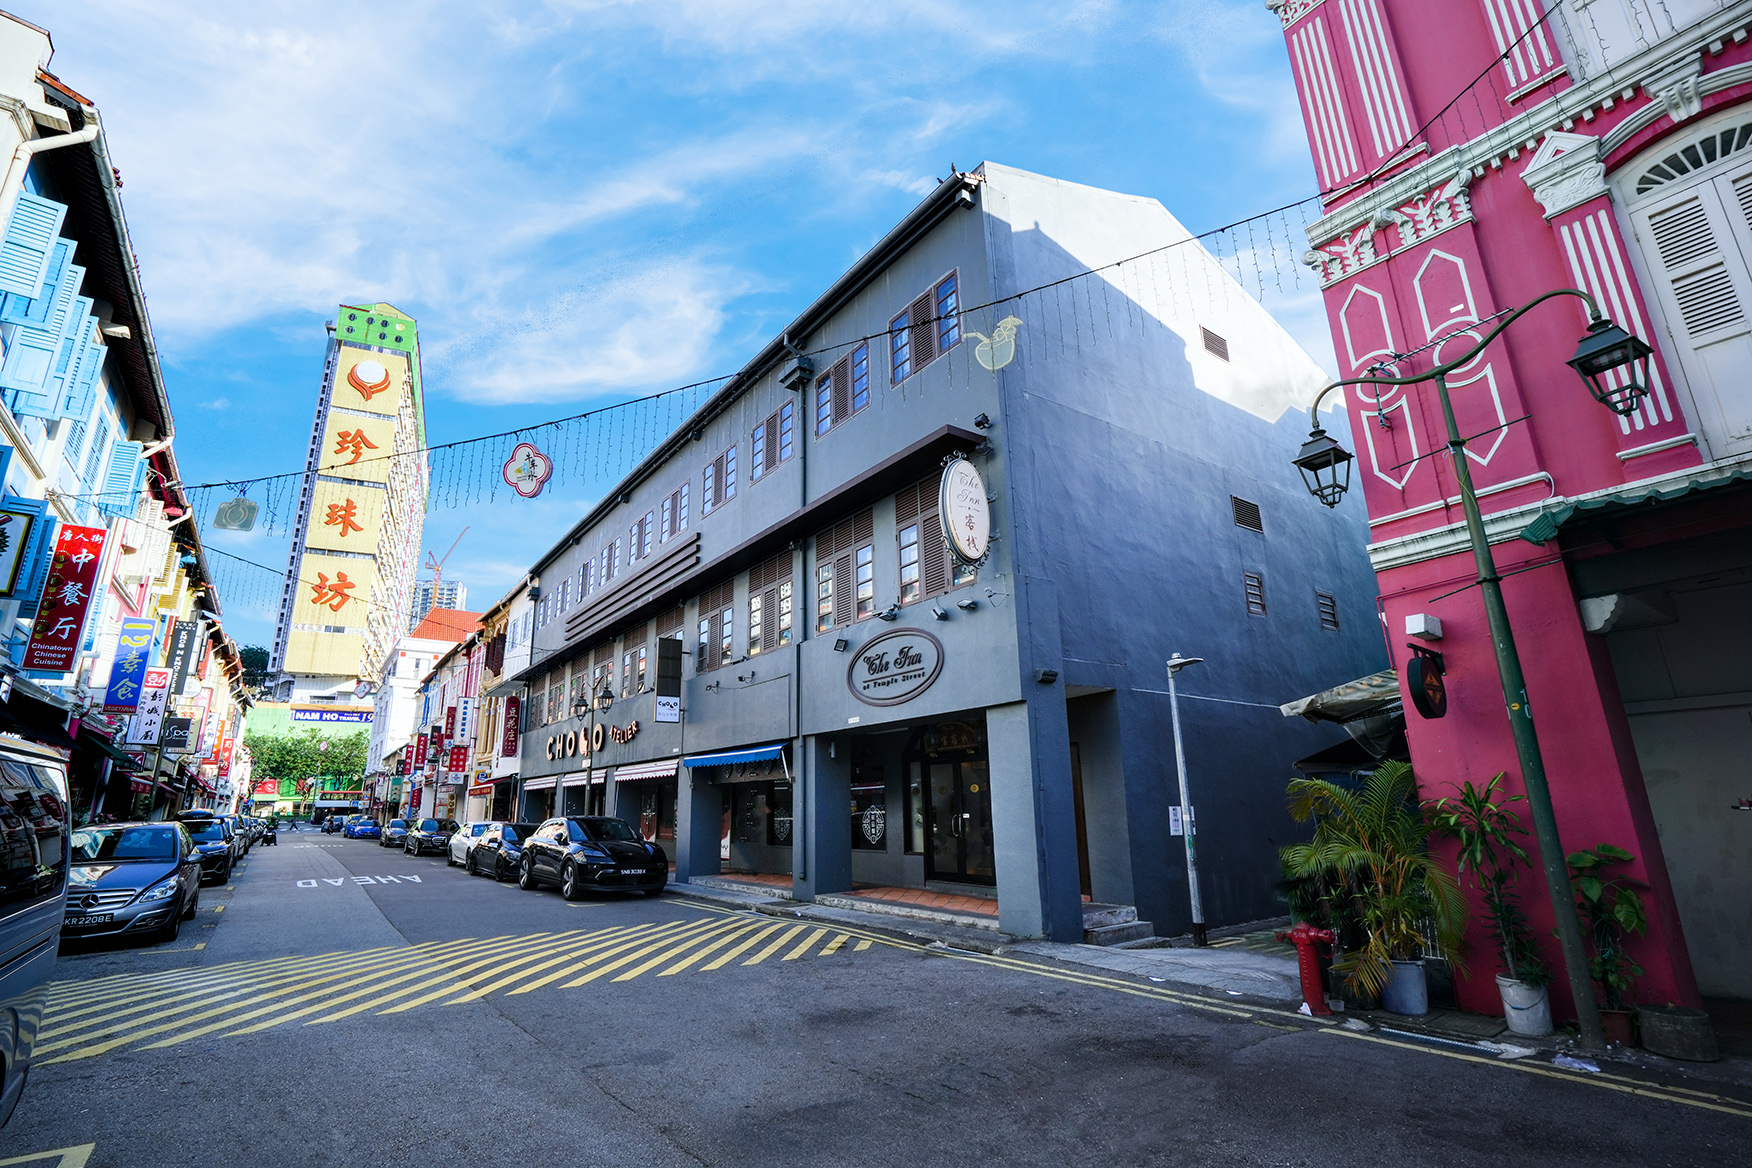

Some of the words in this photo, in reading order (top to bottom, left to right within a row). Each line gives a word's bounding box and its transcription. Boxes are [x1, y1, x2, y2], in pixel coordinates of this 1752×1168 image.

[956, 470, 979, 489] The
[957, 488, 980, 505] Inn
[311, 428, 379, 612] 珍珠坊
[60, 529, 104, 544] 唐人街
[48, 548, 95, 640] 中餐厅
[31, 643, 73, 652] Chinatown
[34, 650, 66, 659] Chinese
[33, 658, 63, 666] Cuisine
[110, 623, 154, 700] 一心素食
[863, 652, 889, 675] The
[894, 646, 922, 669] Inn
[873, 678, 898, 688] Temple
[902, 671, 925, 682] Street
[104, 703, 137, 713] VEGETARIAN
[295, 711, 320, 720] NAM
[322, 713, 339, 721] HO
[608, 720, 640, 744] ATELIER
[296, 874, 423, 888] AHEAD
[63, 914, 112, 925] KR2208E
